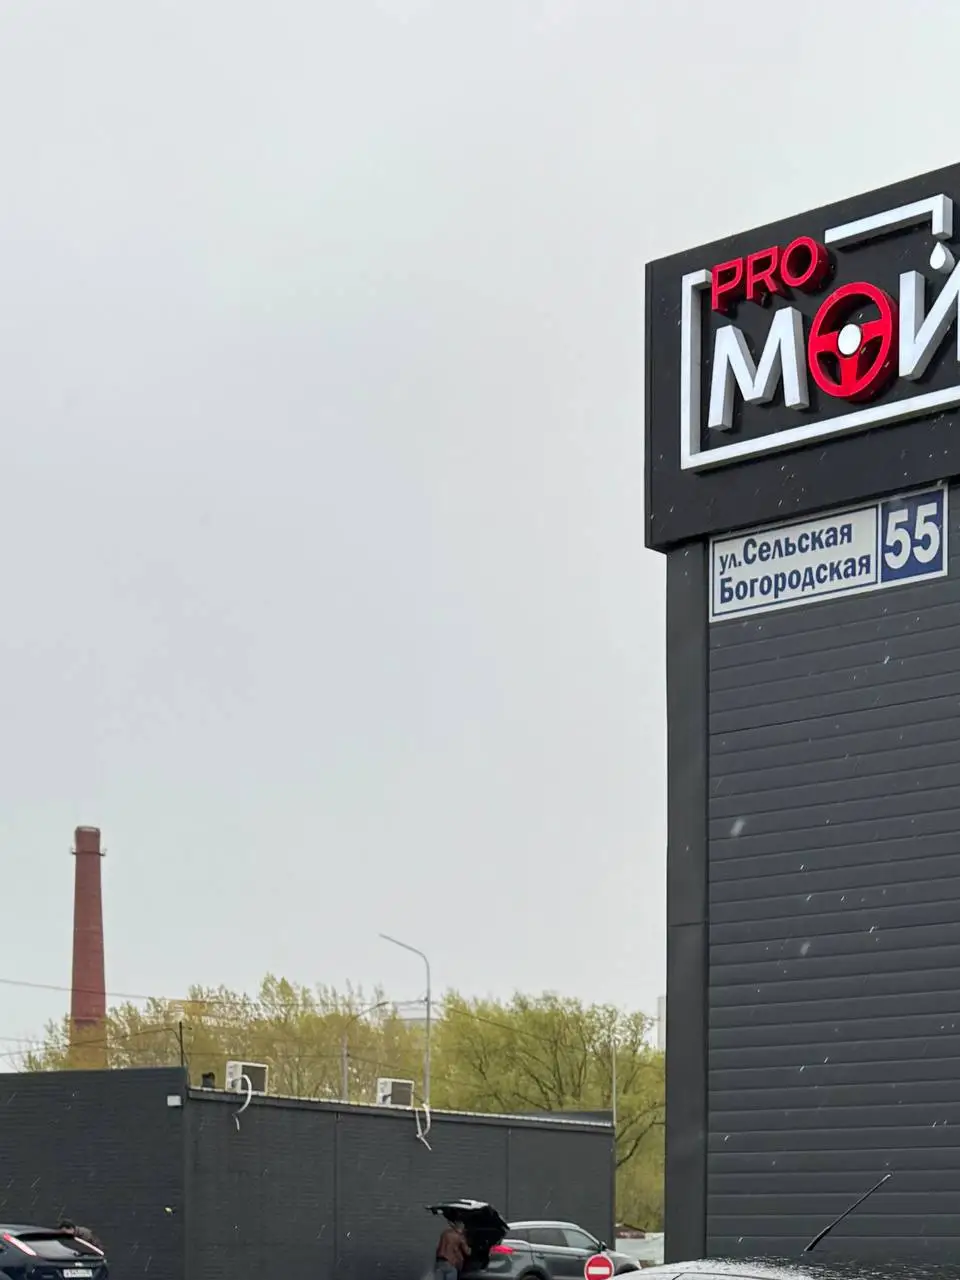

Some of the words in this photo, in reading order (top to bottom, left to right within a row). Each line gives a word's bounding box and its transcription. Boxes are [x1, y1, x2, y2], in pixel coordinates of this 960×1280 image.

[711, 236, 828, 313] PRO
[884, 502, 941, 570] 55
[719, 554, 871, 604] Богородская
